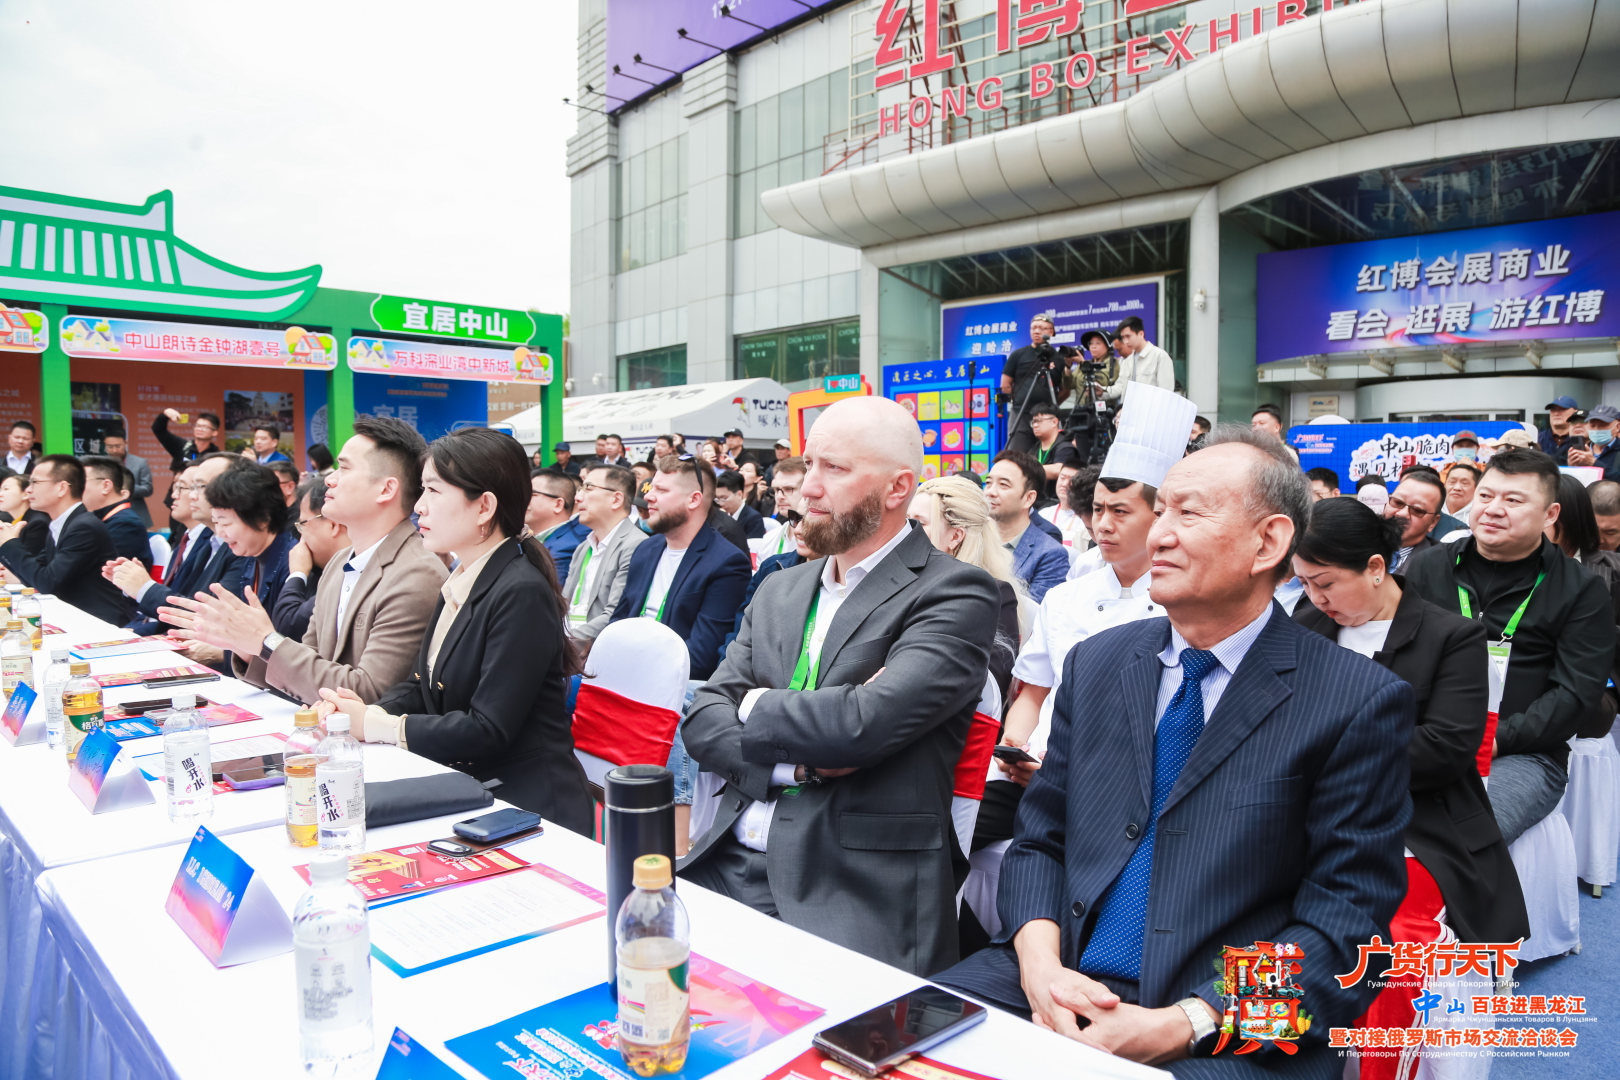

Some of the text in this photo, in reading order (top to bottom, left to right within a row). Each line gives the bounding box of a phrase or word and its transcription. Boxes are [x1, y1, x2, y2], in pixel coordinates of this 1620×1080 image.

[880, 76, 1004, 138] HONG
[1029, 51, 1097, 101] BO
[1356, 244, 1571, 293] 红博会展商业
[402, 302, 509, 339] 宜居中山
[965, 321, 1018, 336] 红博会展商业
[1326, 290, 1605, 341] 看会 逛展 游红博
[124, 332, 281, 358] 中山朗诗金钟湖壹号
[393, 350, 511, 374] 万科深业湾中新城
[839, 377, 858, 389] 中山
[182, 756, 205, 791] 喝开水
